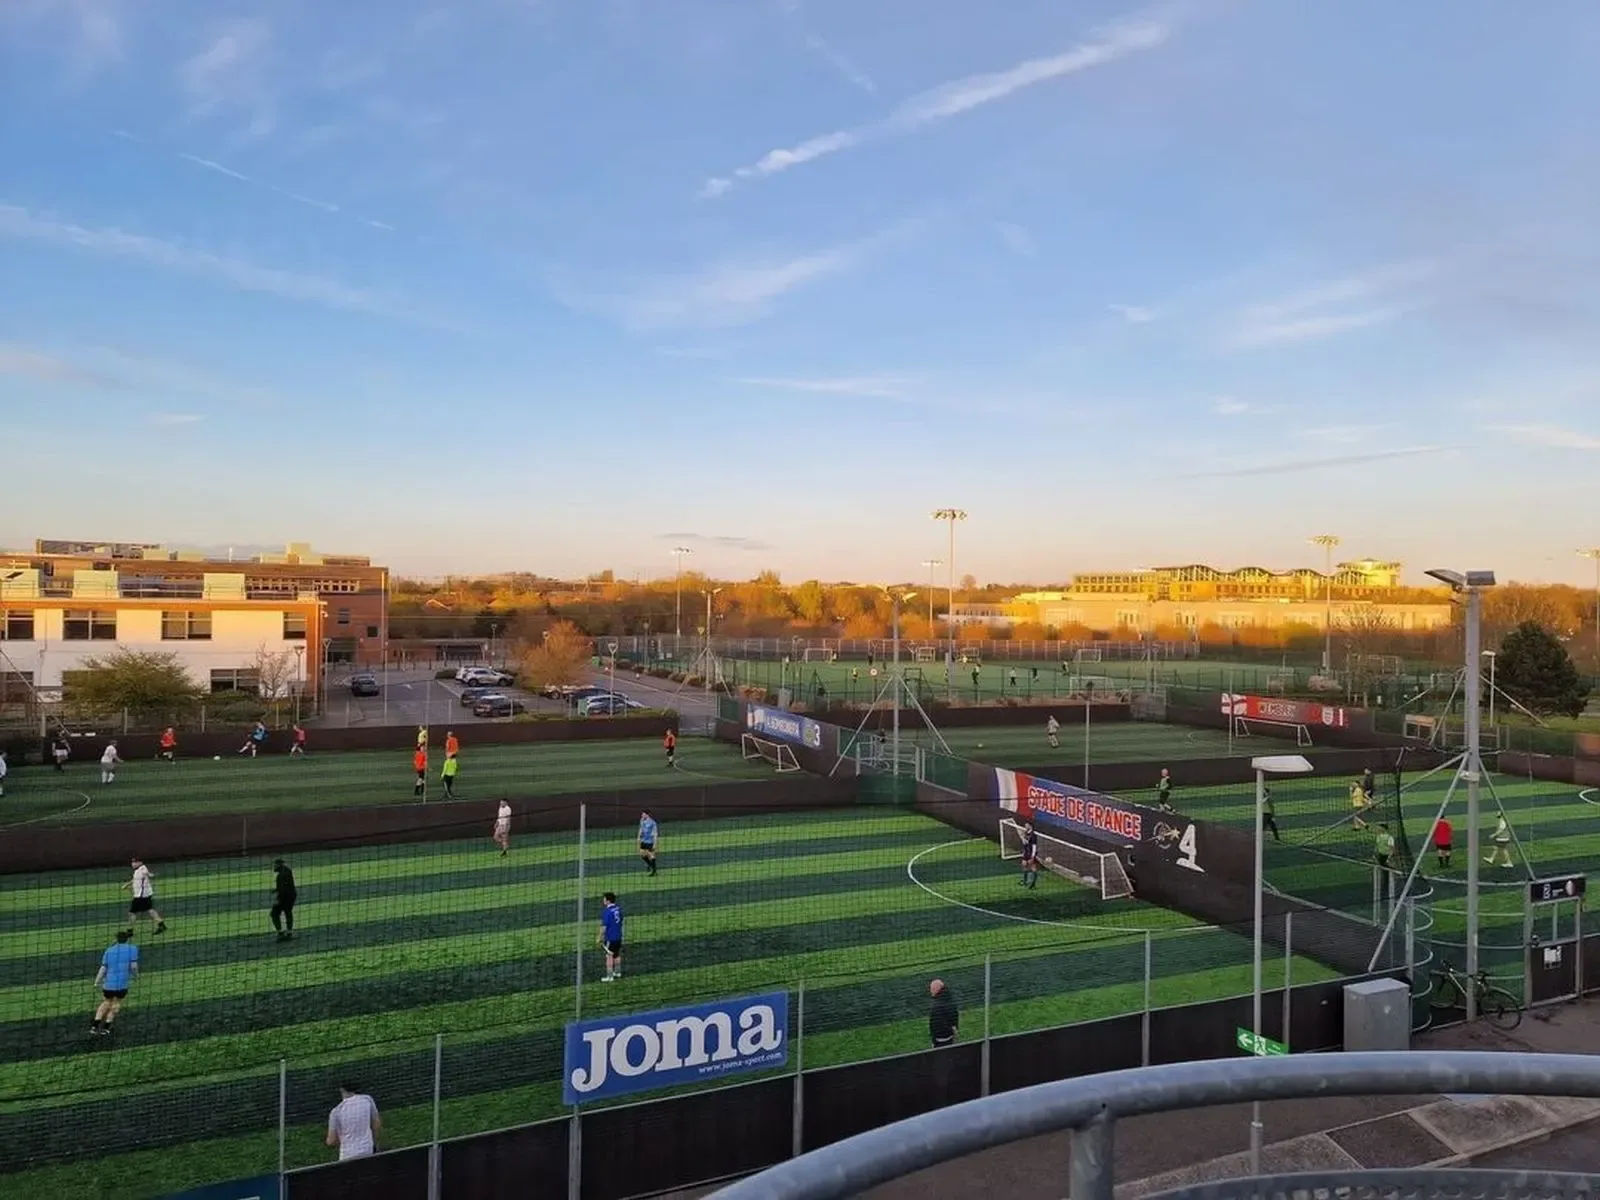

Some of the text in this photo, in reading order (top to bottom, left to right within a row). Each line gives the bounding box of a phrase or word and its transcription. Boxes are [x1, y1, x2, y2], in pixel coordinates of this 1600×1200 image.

[813, 723, 821, 747] 3
[1027, 785, 1142, 841] STADE DE FRANCE
[1176, 823, 1206, 873] 4
